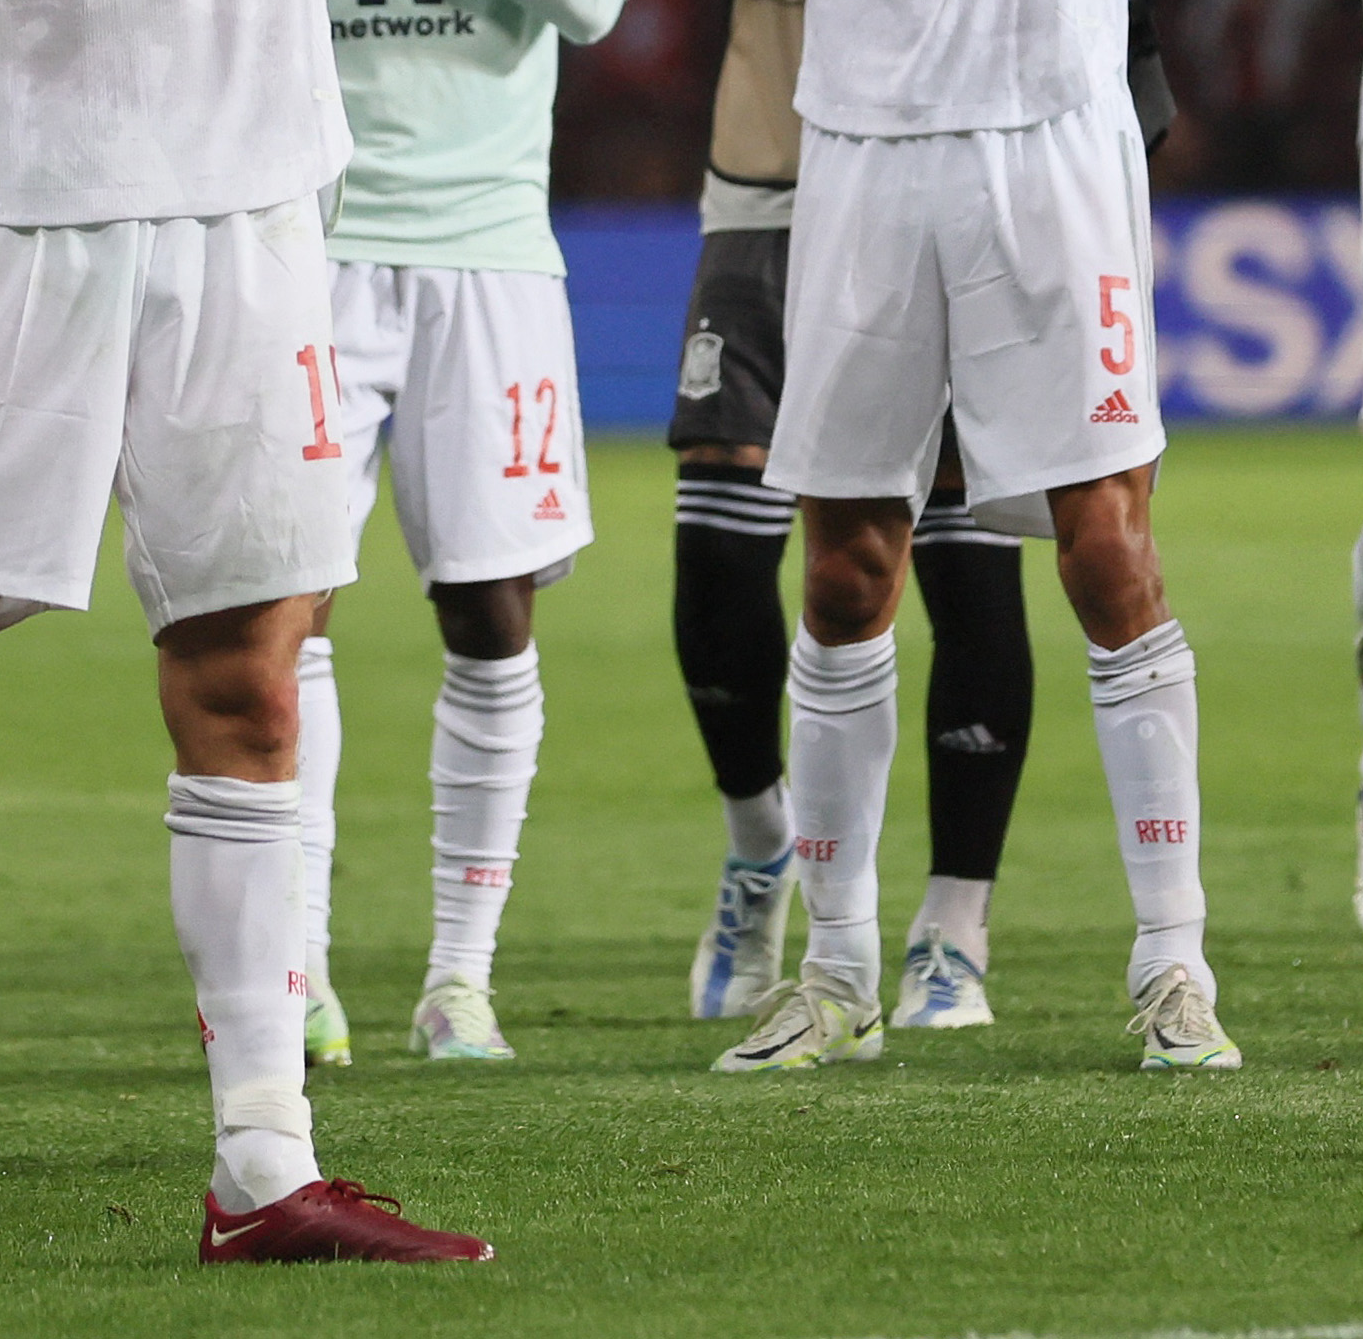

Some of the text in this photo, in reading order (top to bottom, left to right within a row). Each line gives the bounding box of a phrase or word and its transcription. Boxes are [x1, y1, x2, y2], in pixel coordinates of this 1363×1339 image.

[332, 10, 475, 40] network
[1098, 275, 1135, 376] 5
[296, 344, 342, 460] 1
[1090, 409, 1140, 424] adidas
[503, 378, 561, 478] 12
[1135, 819, 1187, 845] RFEF
[795, 835, 839, 863] RFEF
[287, 970, 307, 996] RF
